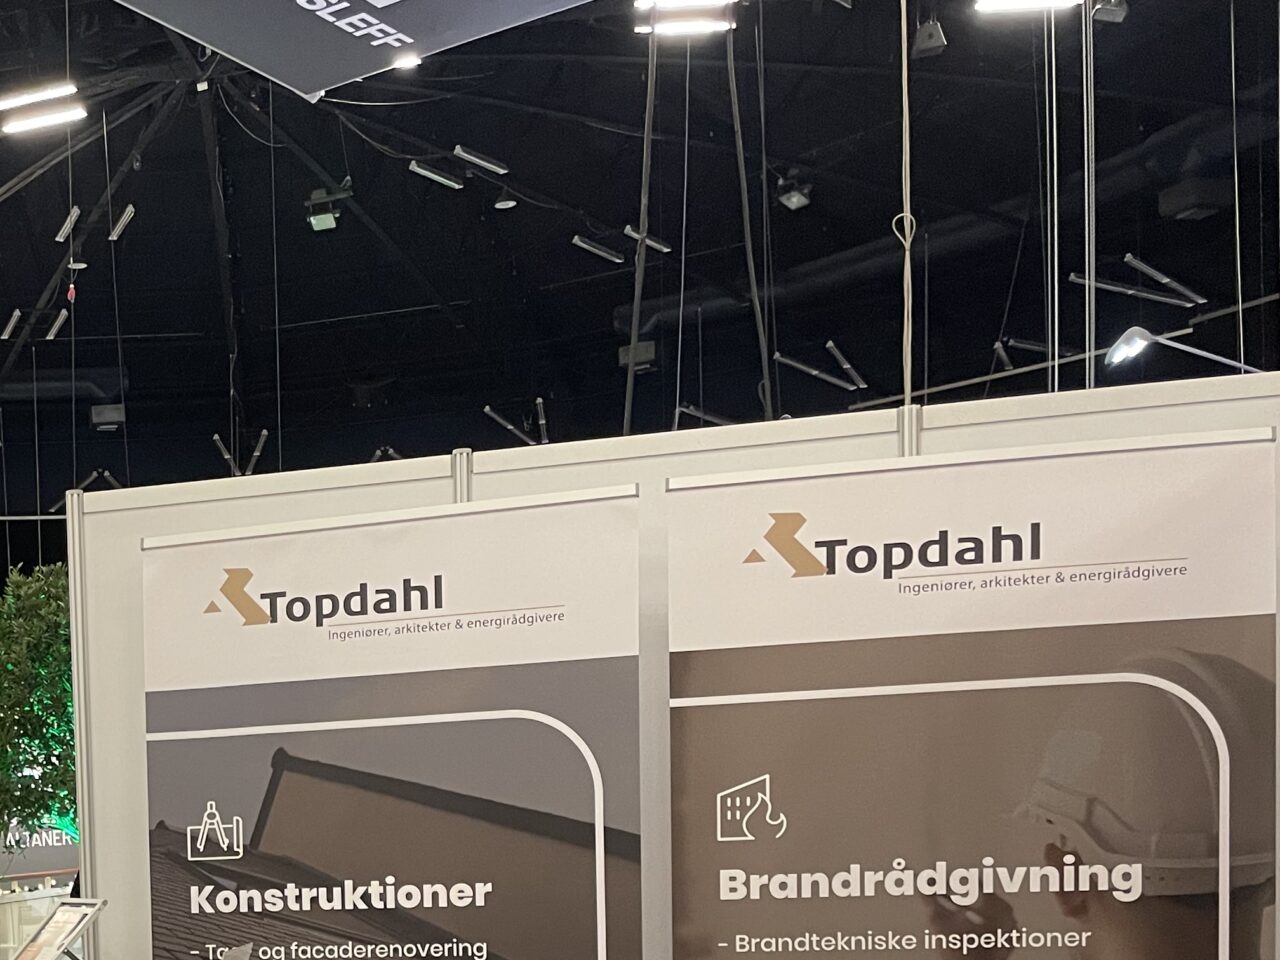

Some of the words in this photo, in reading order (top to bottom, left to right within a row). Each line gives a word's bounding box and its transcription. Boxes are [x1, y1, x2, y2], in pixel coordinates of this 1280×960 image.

[814, 522, 1041, 580] Topdahl
[898, 578, 976, 596] Ingeniører,
[980, 571, 1050, 588] arkitekter
[1055, 570, 1065, 584] &
[1069, 562, 1188, 584] energirådgivere
[260, 575, 444, 627] Topdahl
[328, 626, 391, 641] Ingeniører,
[394, 619, 451, 637] arkitekter
[454, 618, 464, 630] &
[467, 610, 565, 630] energirådgivere
[189, 876, 493, 913] Konstruktioner
[719, 855, 1143, 906] Brandrådgivning
[735, 930, 917, 953] Brandtekniske
[924, 928, 1091, 955] inspektioner
